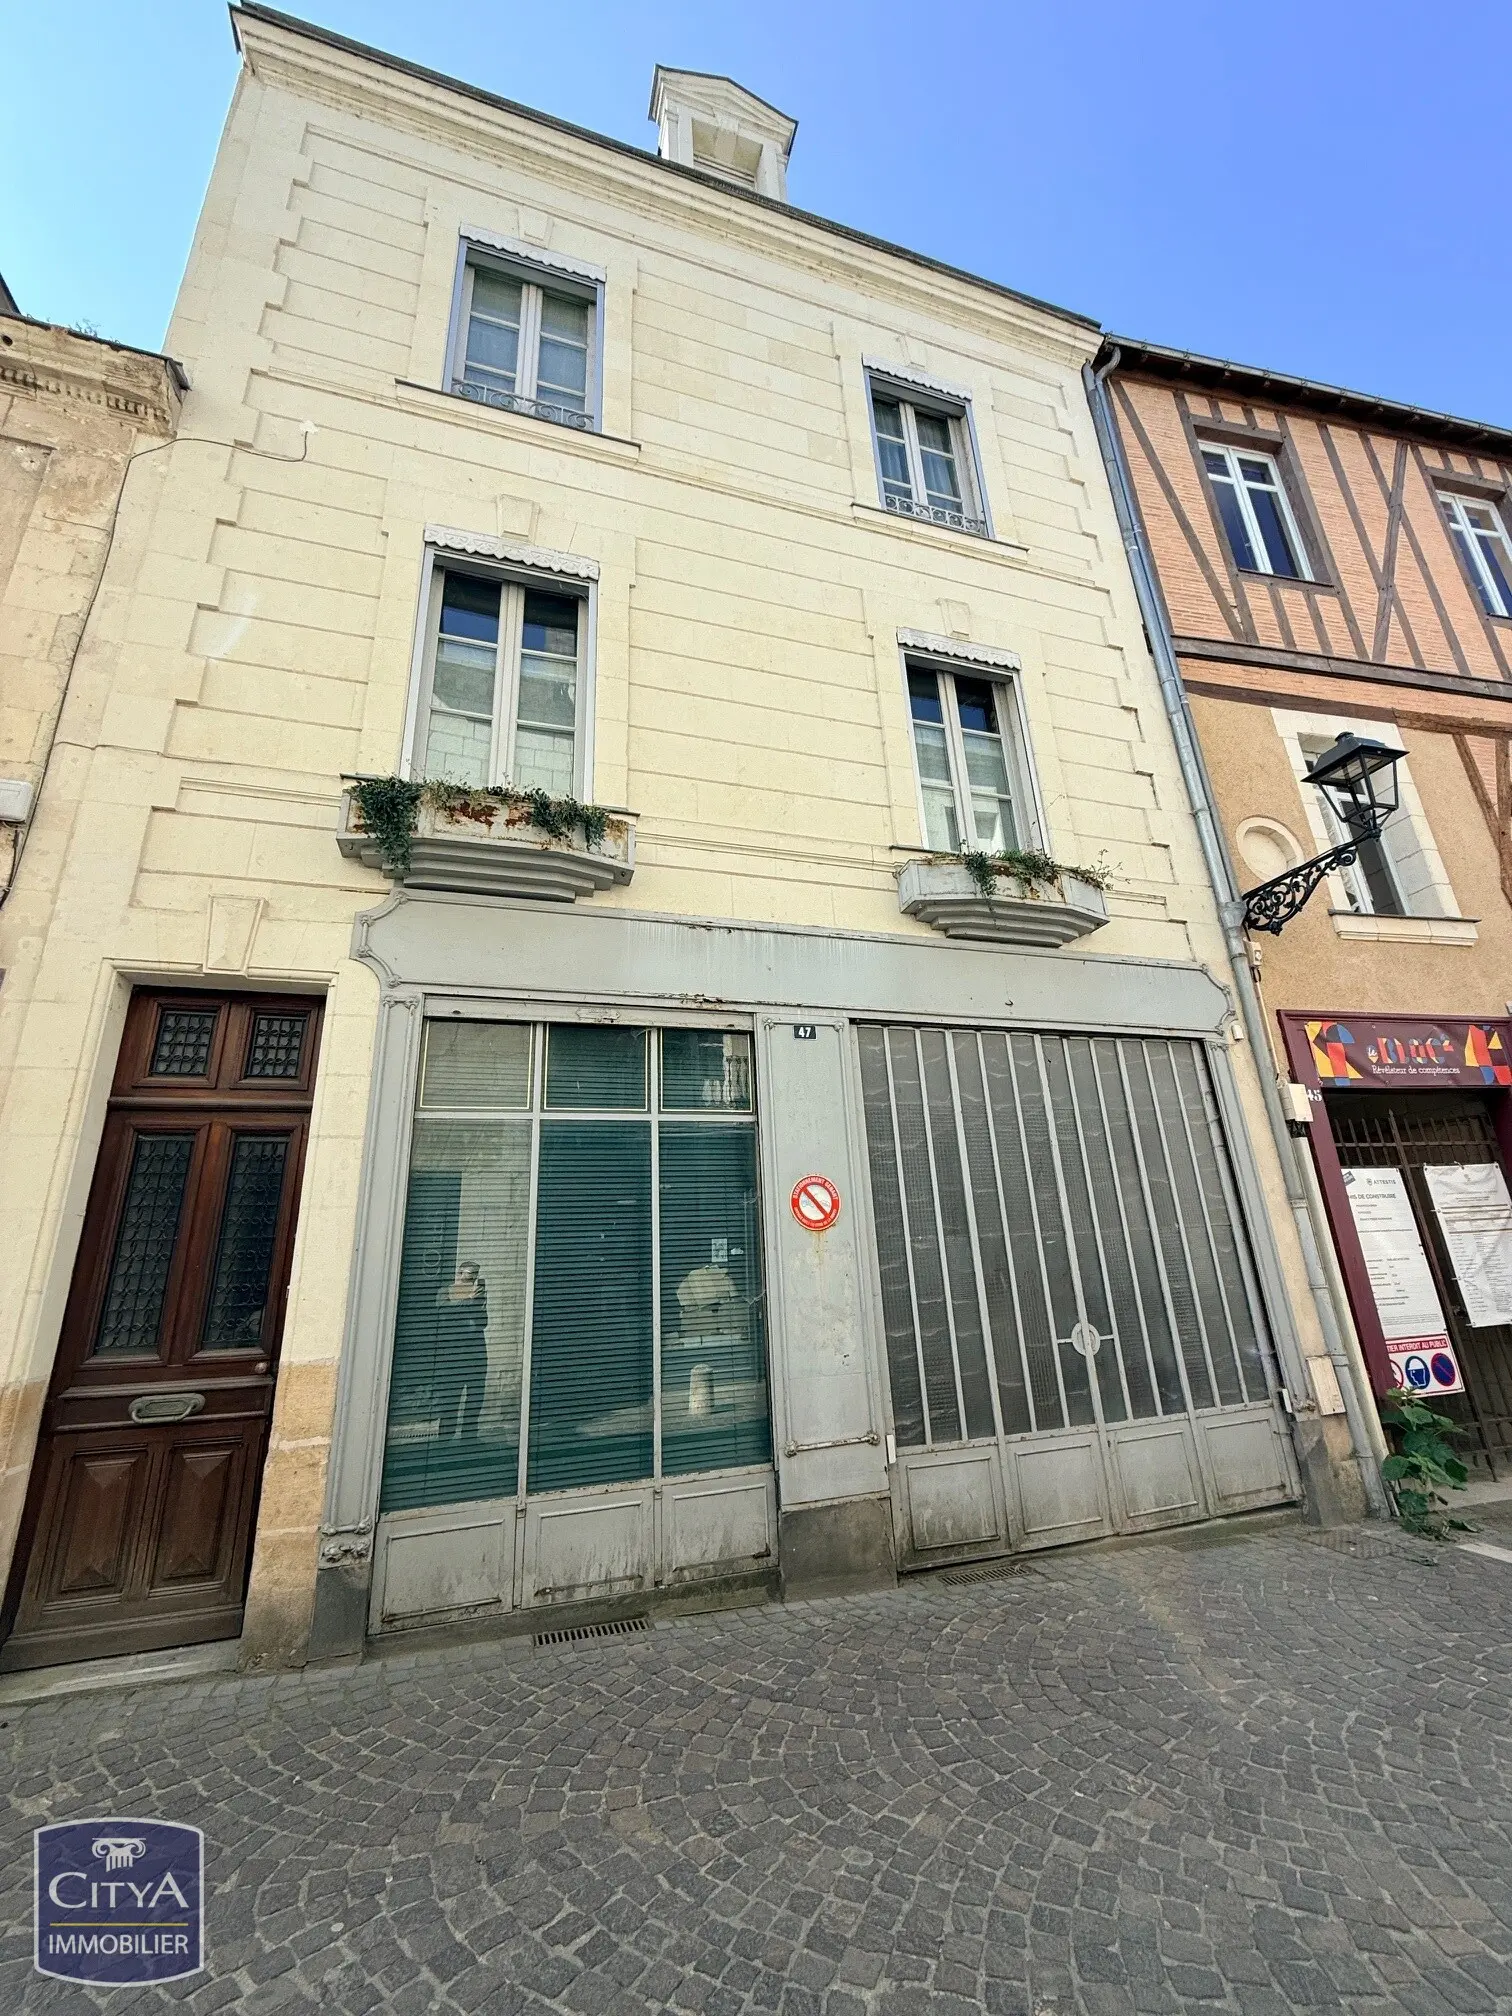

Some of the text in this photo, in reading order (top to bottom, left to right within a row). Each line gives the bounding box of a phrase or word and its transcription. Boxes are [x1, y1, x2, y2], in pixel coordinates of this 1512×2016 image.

[798, 1027, 811, 1038] 47
[1409, 1065, 1418, 1074] de
[1306, 1089, 1323, 1102] 45
[1398, 1342, 1421, 1351] INTERDIT
[1421, 1341, 1430, 1349] AU
[1429, 1340, 1448, 1348] PUBLIC
